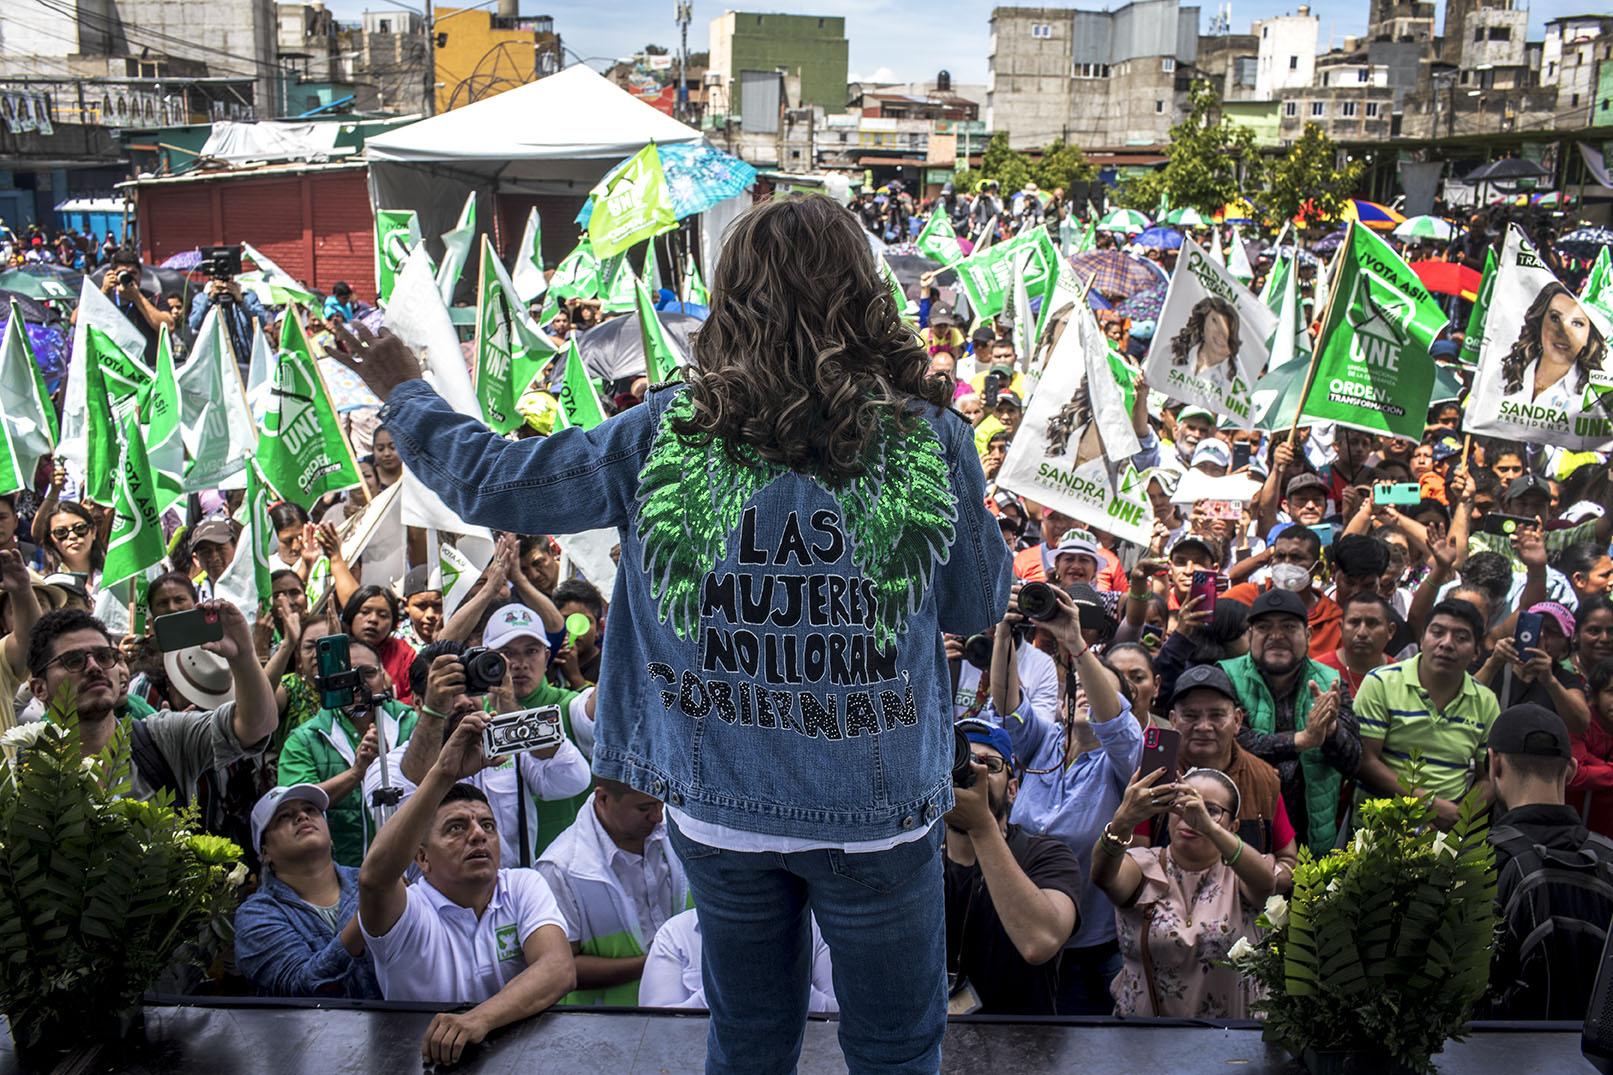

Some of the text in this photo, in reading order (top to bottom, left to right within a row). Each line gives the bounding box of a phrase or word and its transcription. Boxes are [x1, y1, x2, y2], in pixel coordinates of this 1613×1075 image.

[1349, 332, 1402, 372] UNE
[560, 381, 577, 417] OTA
[1225, 395, 1250, 420] UNE
[1329, 378, 1387, 402] ORDEN
[1498, 415, 1571, 433] PRESIDENTA
[1500, 401, 1569, 425] SANDRA
[126, 455, 142, 493] OTA
[1038, 463, 1106, 501] SANDRA
[1034, 475, 1145, 527] PRESIDENTA UNE
[738, 505, 846, 567] LAS
[702, 572, 878, 631] MUJERES
[648, 662, 918, 741] GOBIERNAN
